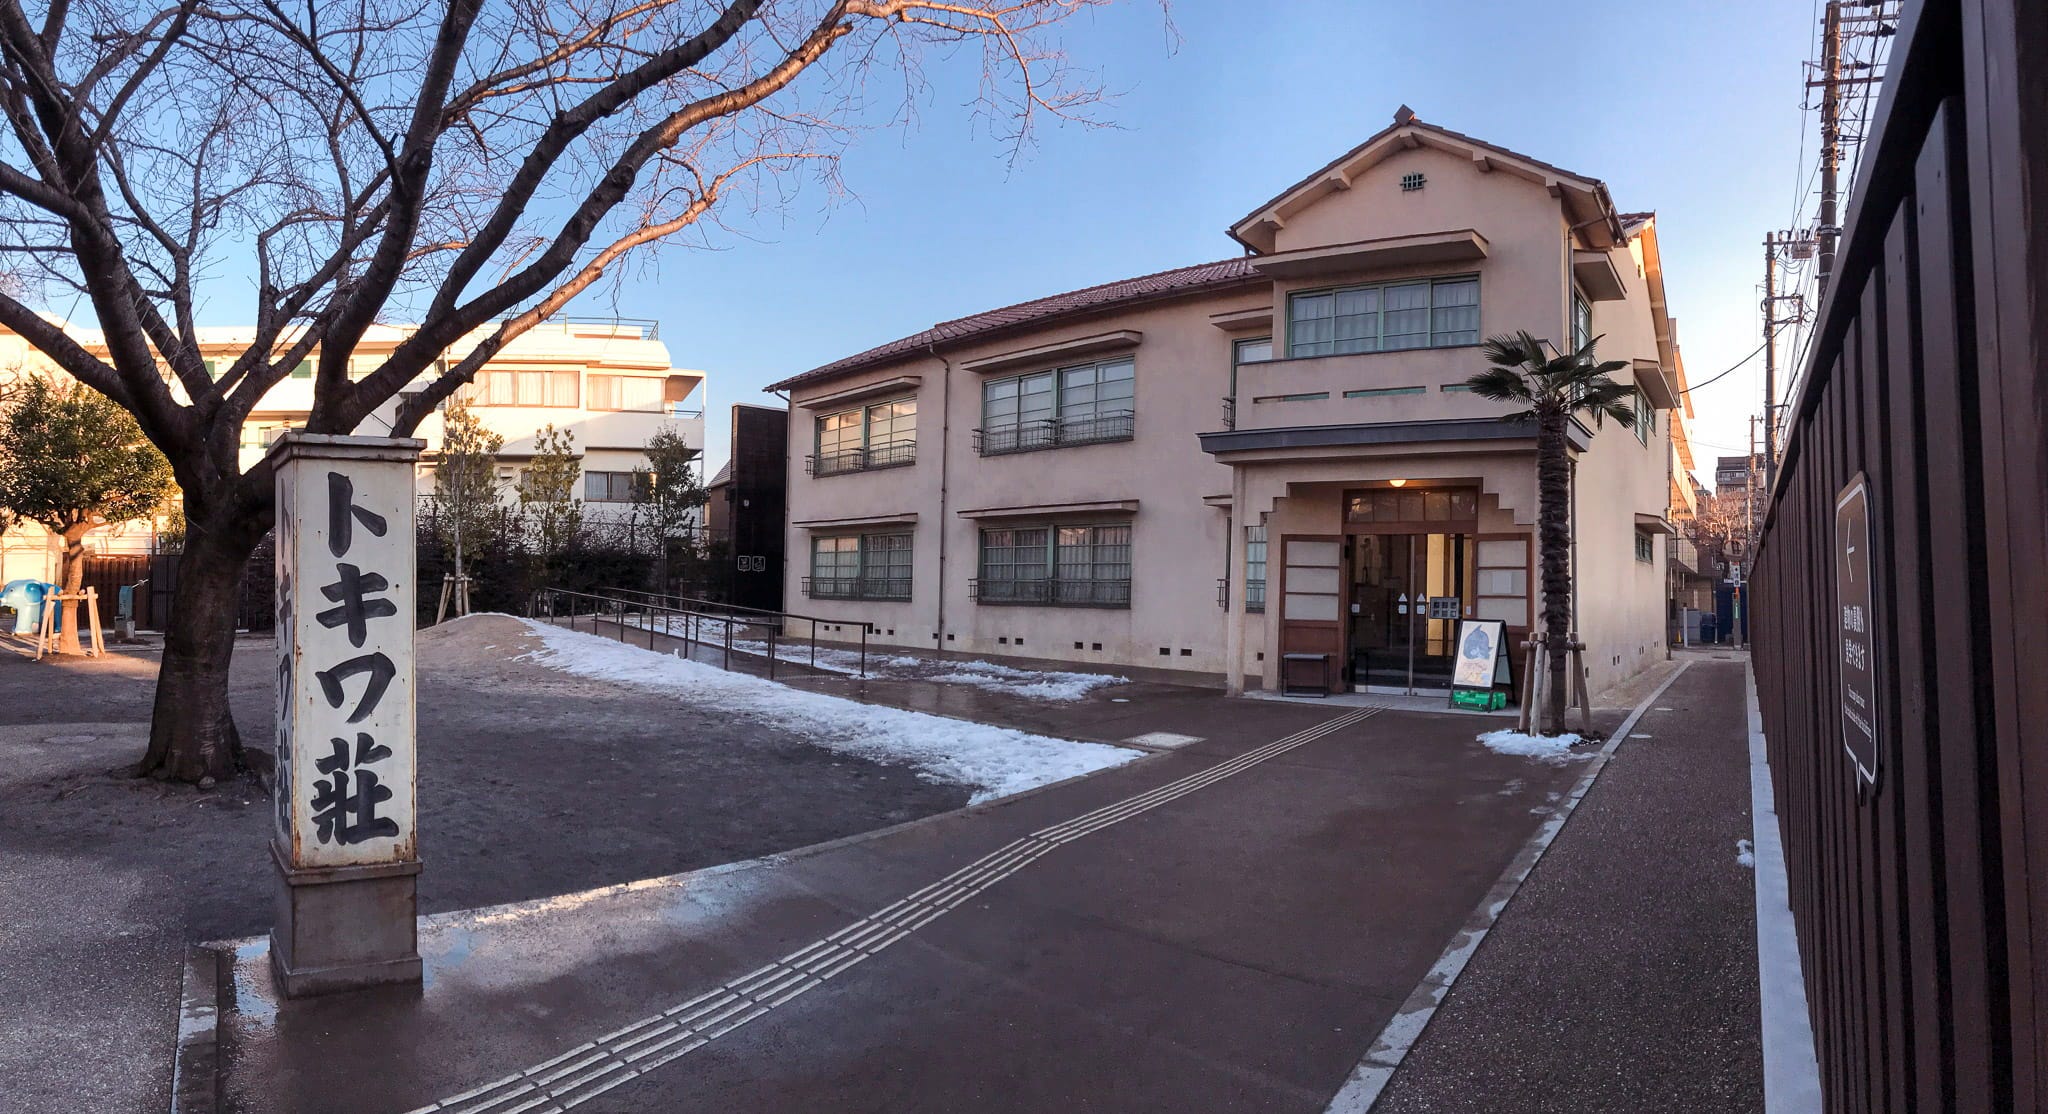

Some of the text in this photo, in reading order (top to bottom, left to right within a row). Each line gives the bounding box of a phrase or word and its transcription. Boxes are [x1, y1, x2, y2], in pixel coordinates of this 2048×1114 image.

[279, 477, 291, 834] トキワ荘
[310, 472, 399, 846] トキワ荘
